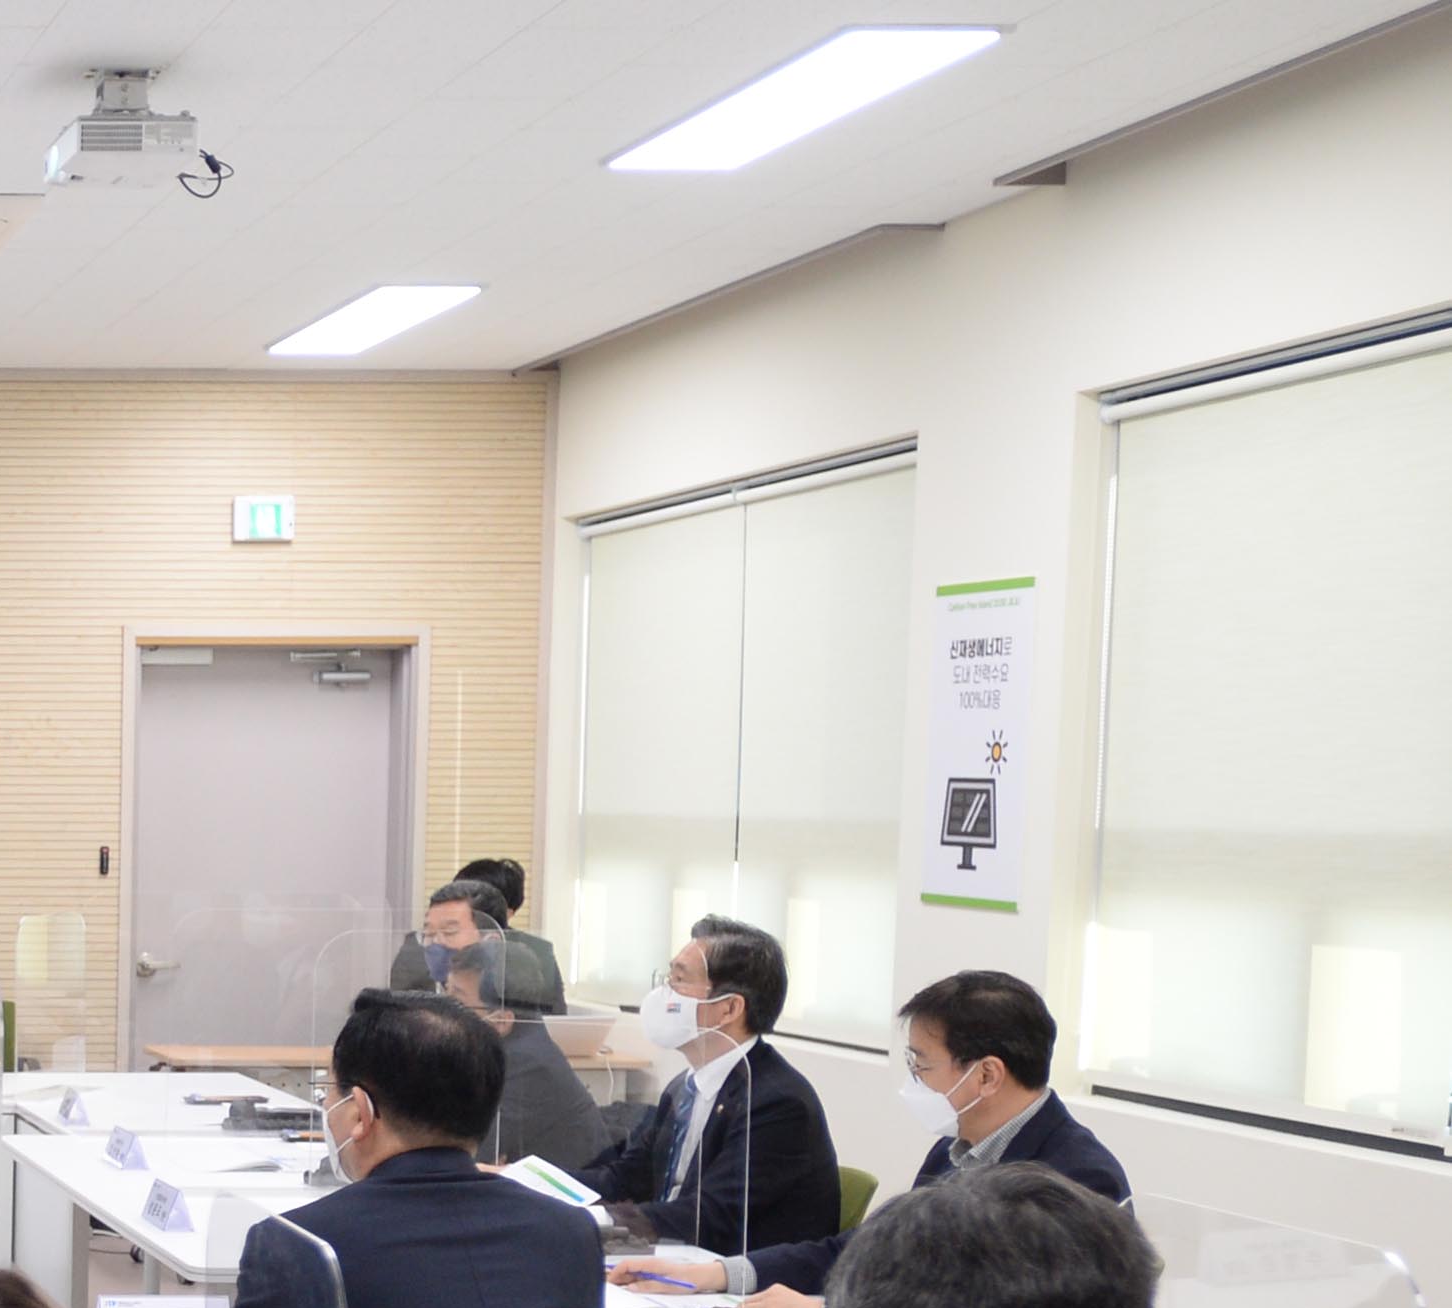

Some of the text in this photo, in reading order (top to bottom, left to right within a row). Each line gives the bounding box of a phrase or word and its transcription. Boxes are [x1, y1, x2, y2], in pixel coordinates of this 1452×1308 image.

[950, 636, 1013, 660] 신재생에너지로
[953, 663, 1009, 685] 도내 전력수요
